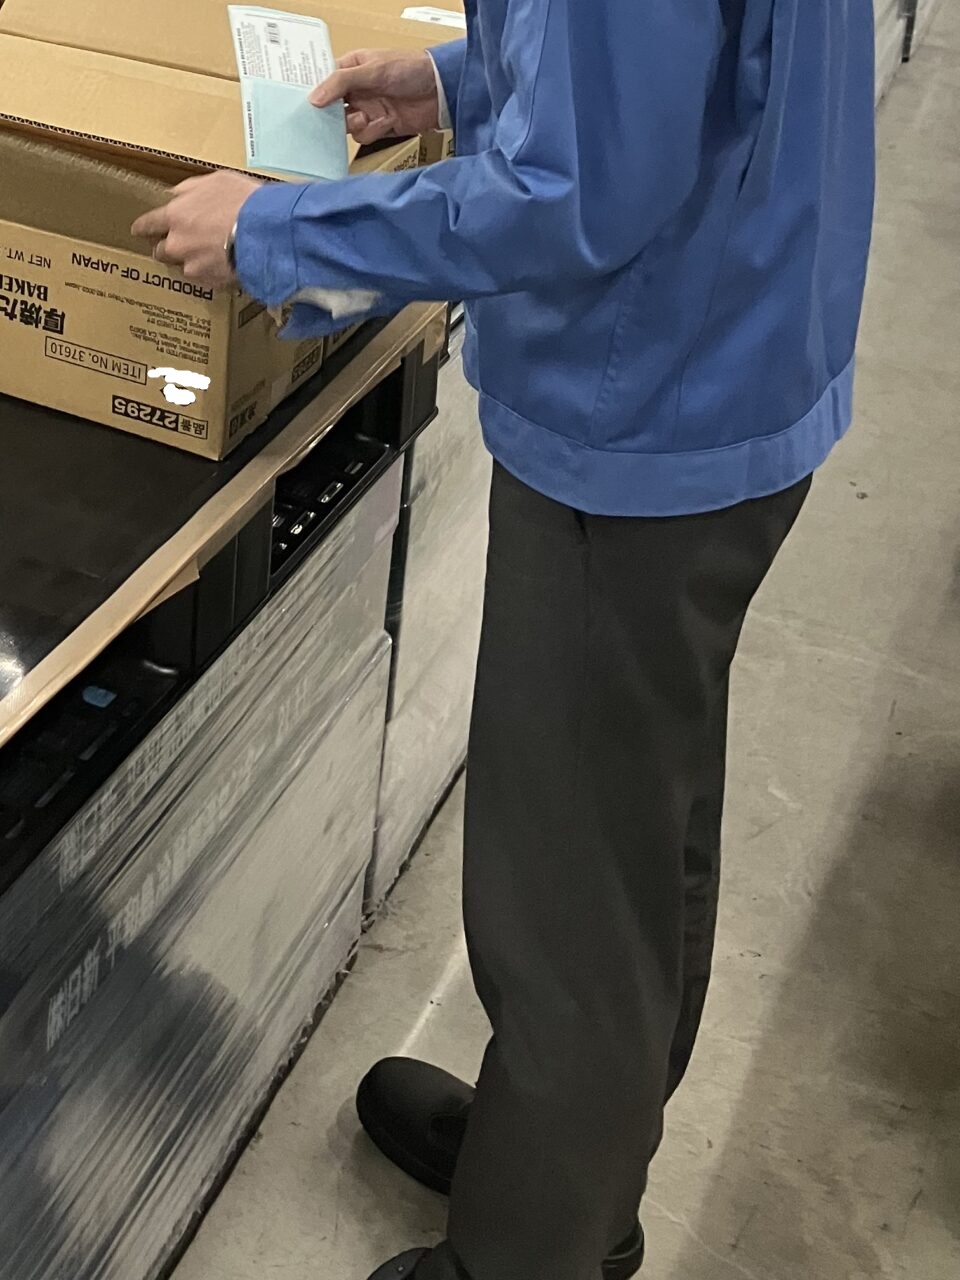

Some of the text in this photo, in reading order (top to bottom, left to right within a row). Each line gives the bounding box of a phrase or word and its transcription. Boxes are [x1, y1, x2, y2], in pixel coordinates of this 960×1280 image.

[3, 247, 25, 262] WT.
[28, 254, 51, 269] NET
[71, 253, 214, 300] PRODUCT OF JAPAN
[157, 319, 209, 338] MANUFACTURED
[50, 342, 142, 379] ITEM No. 37610
[166, 348, 208, 364] DISTRIBUTED
[113, 397, 206, 436] 品番 27295
